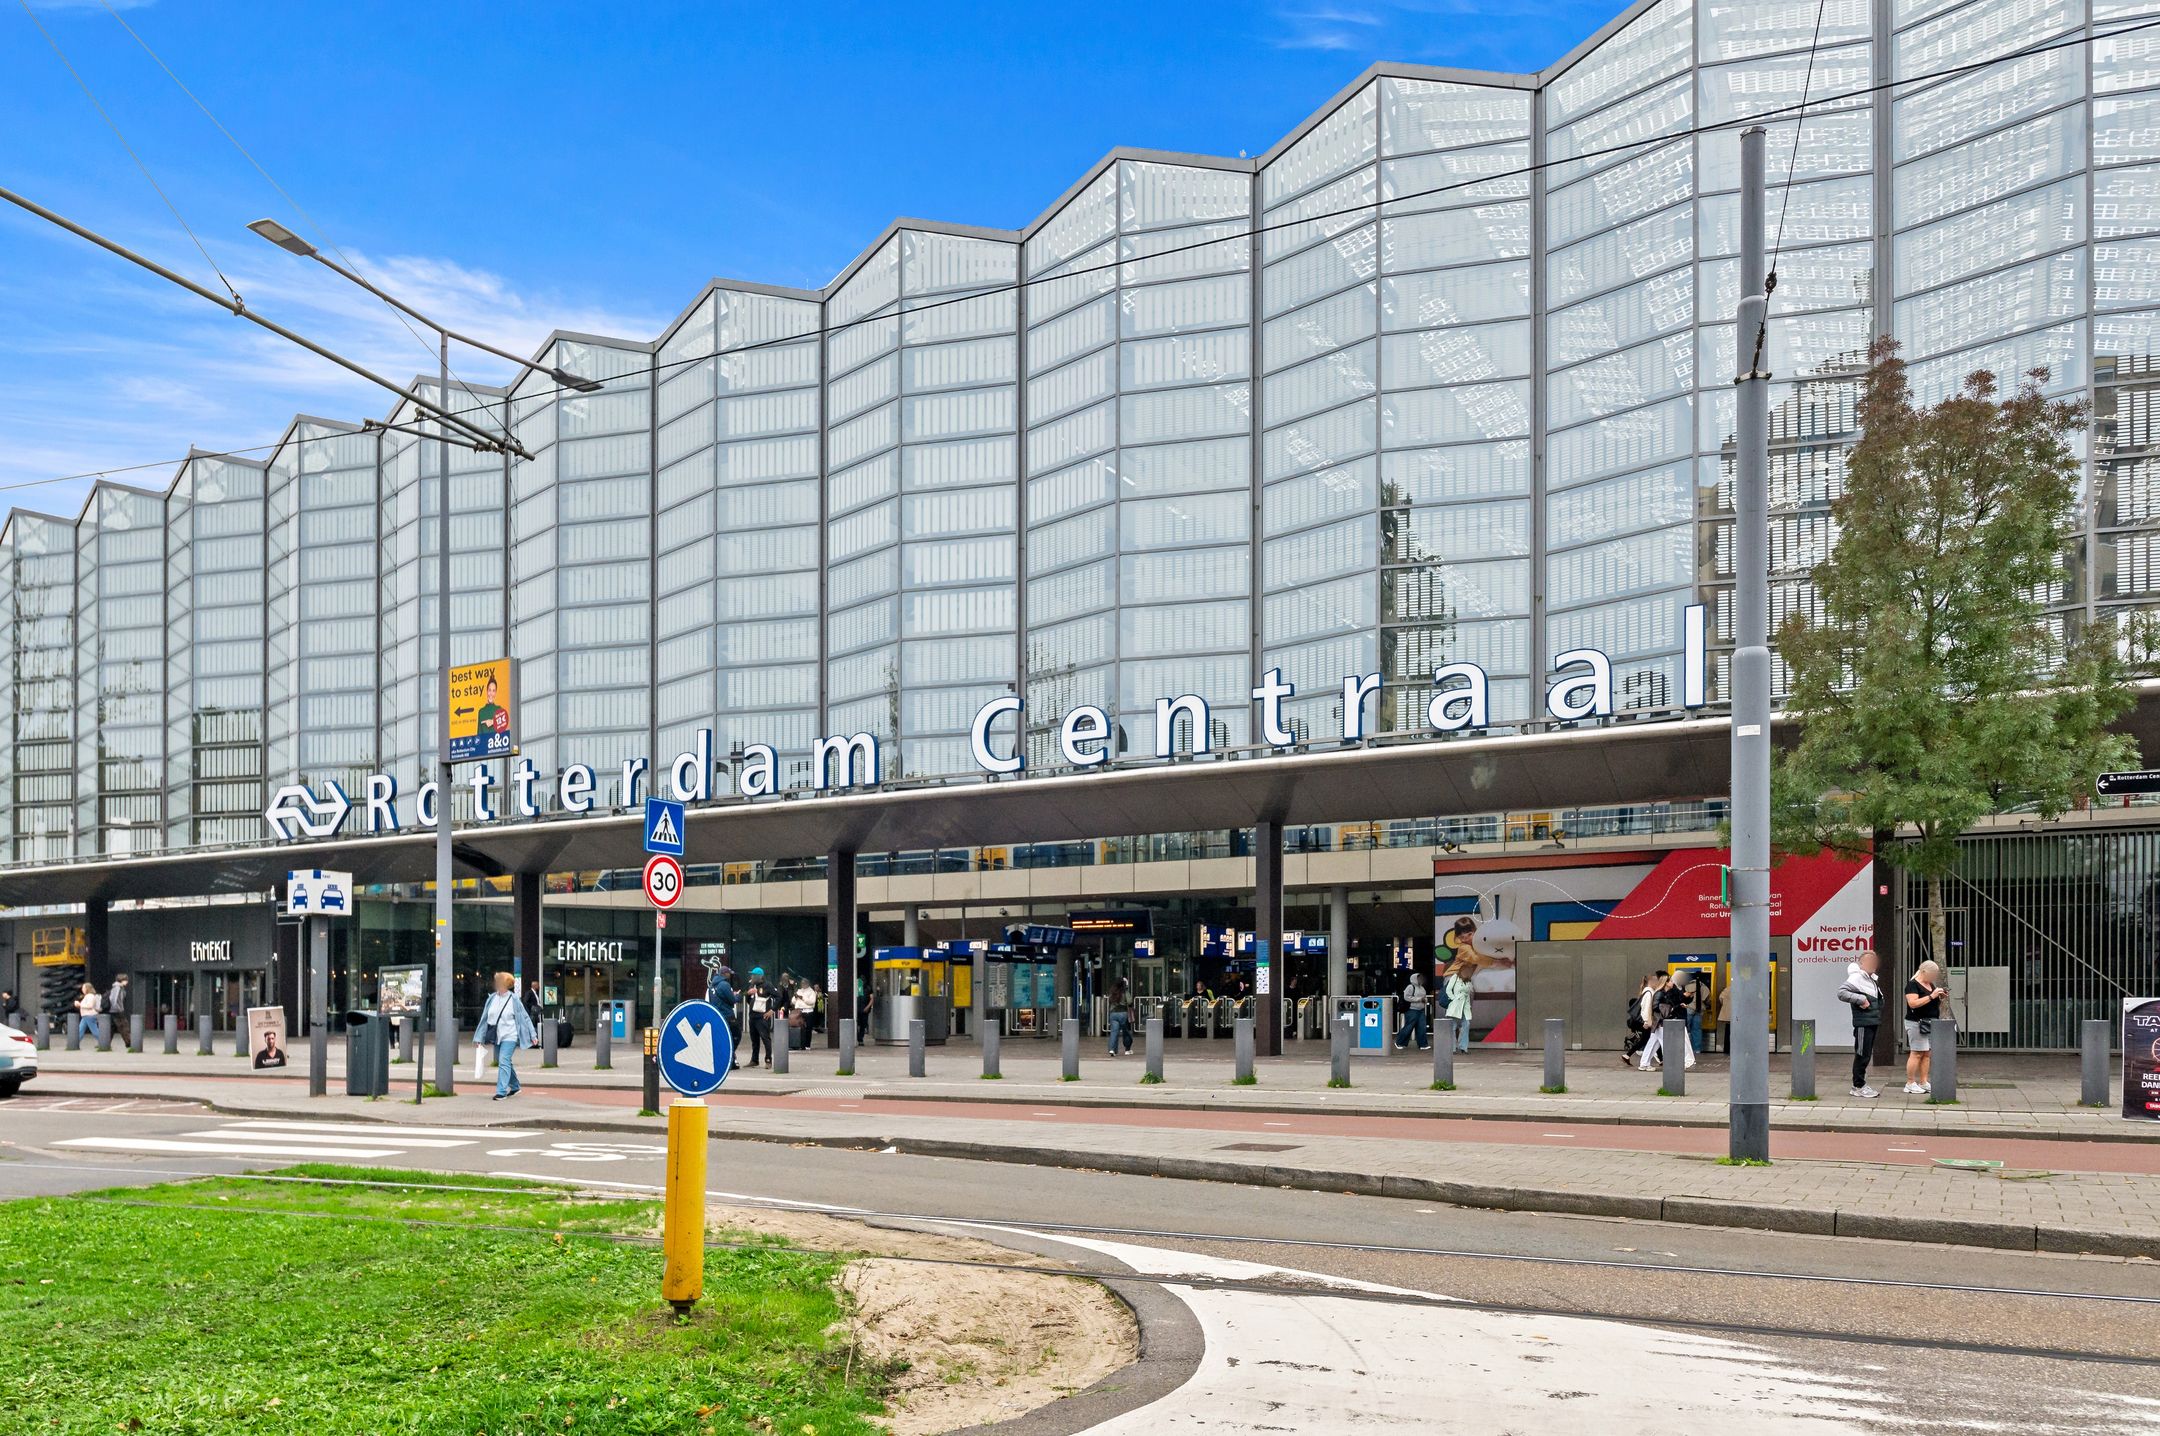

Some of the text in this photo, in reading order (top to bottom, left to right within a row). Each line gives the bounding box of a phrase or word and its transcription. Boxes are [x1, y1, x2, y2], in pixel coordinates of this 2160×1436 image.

[451, 667, 495, 683] best way
[451, 684, 484, 698] to stay
[367, 604, 1707, 832] Rotterdam Central
[487, 733, 509, 749] a&o
[1612, 821, 1619, 831] 2
[1439, 832, 1446, 841] 2
[1283, 841, 1290, 850] 2
[653, 872, 676, 891] 30
[1848, 924, 1856, 933] je
[191, 940, 231, 961] EKMEKCI
[557, 940, 622, 961] EKMEKCI
[1797, 955, 1860, 963] ontdek-utrech
[2142, 1073, 2160, 1081] REE
